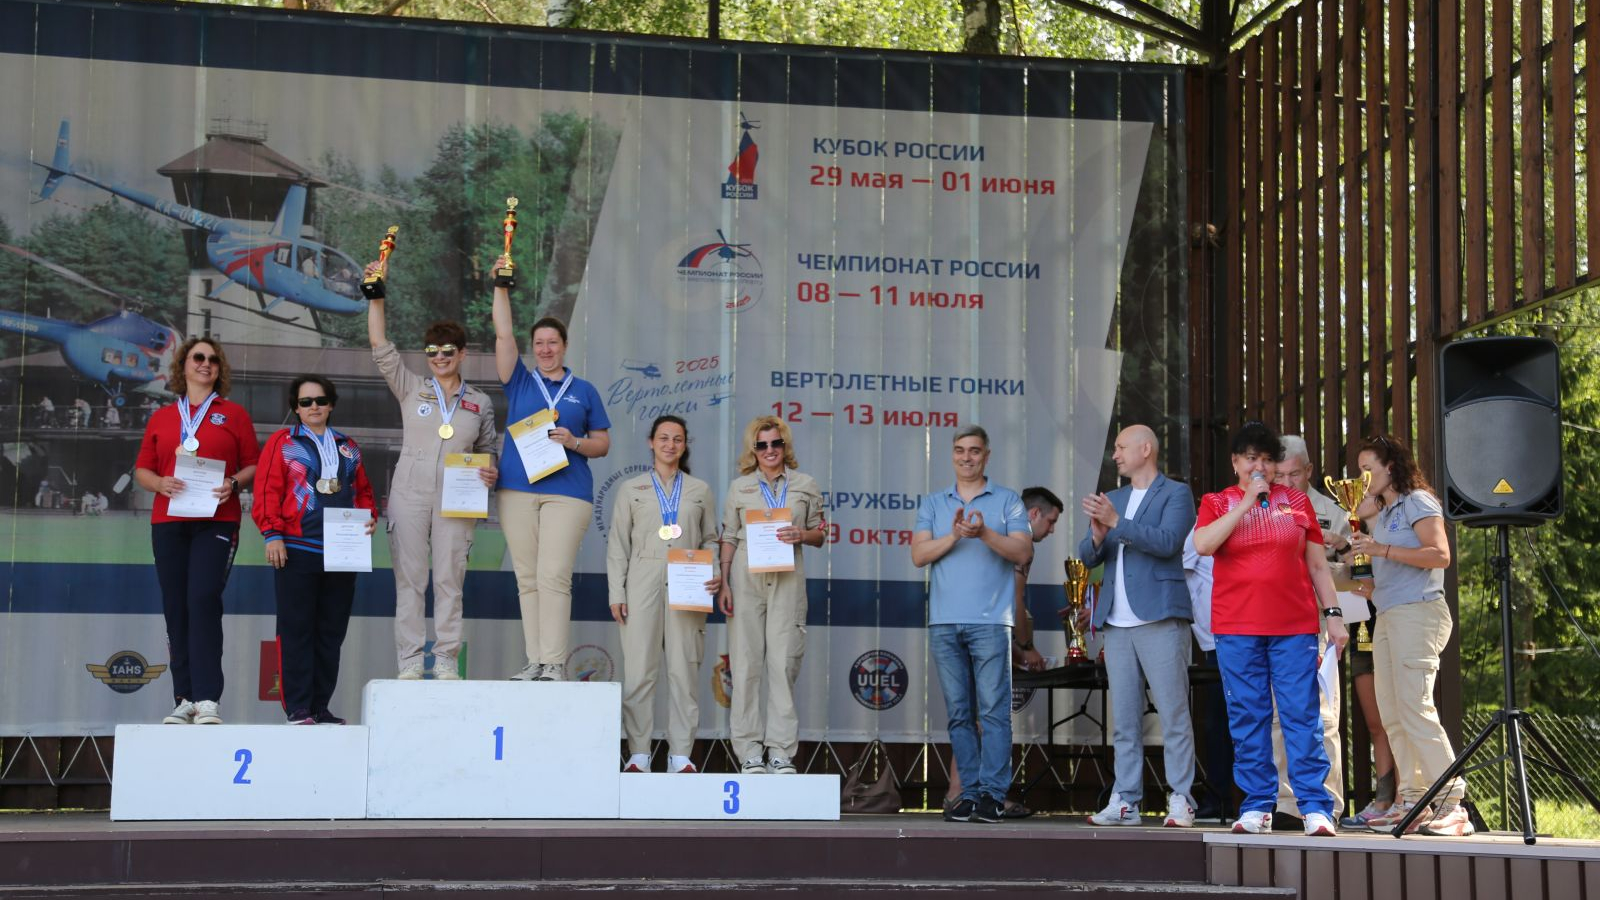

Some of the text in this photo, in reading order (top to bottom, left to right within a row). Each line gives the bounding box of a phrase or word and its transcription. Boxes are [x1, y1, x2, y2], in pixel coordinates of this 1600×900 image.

[813, 138, 985, 161] КУБОК РОССИИ
[810, 165, 842, 187] 29
[850, 172, 903, 189] мая
[942, 171, 970, 192] 01
[981, 177, 1055, 195] июня
[677, 269, 728, 277] ЧЕМПИОНАТ
[798, 253, 1040, 280] ЧЕМПИОНАТ РОССИИ
[797, 282, 830, 303] 08
[870, 285, 897, 306] 11
[909, 291, 984, 309] июля
[675, 355, 719, 374] 2025
[771, 371, 1024, 396] ВЕРТОЛЕТНЫЕ ГОНКИ
[772, 401, 803, 422] 12
[843, 404, 874, 425] 13
[883, 410, 958, 428] июля
[849, 528, 913, 545] октя
[112, 665, 141, 675] IAHS
[857, 674, 900, 687] UUEL
[493, 727, 503, 760] 1
[233, 748, 252, 784] 2
[723, 780, 739, 814] 3
